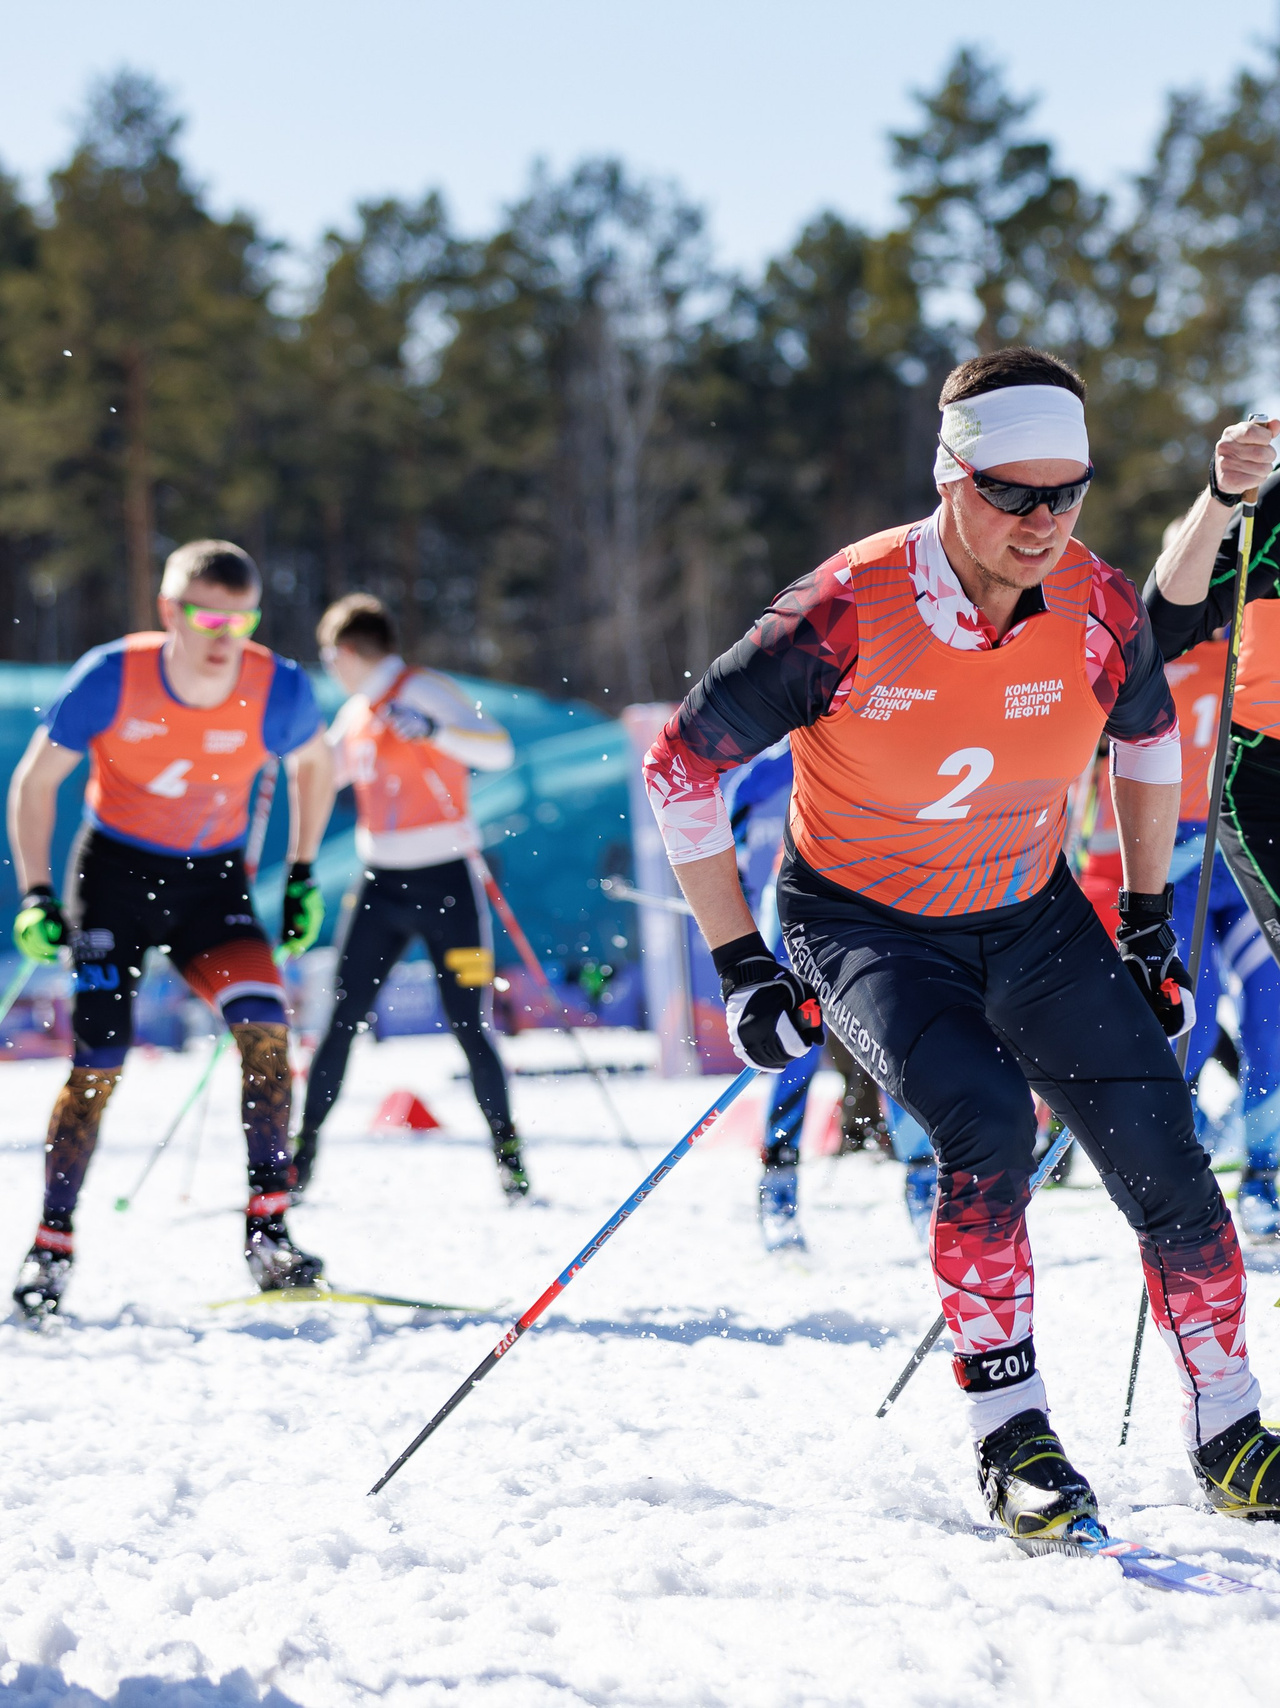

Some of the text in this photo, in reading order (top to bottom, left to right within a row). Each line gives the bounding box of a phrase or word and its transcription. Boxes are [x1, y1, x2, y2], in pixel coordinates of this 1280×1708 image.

[870, 685, 937, 700] ЛЫЖНЫЕ
[1004, 679, 1064, 697] КОМАНДА
[866, 697, 912, 711] ГОНКИ
[1004, 691, 1062, 708] ГАЗПРОМ
[860, 708, 892, 721] 2025
[1004, 704, 1050, 719] НЕФТИ
[915, 747, 994, 820] 2
[985, 1351, 1030, 1381] 102
